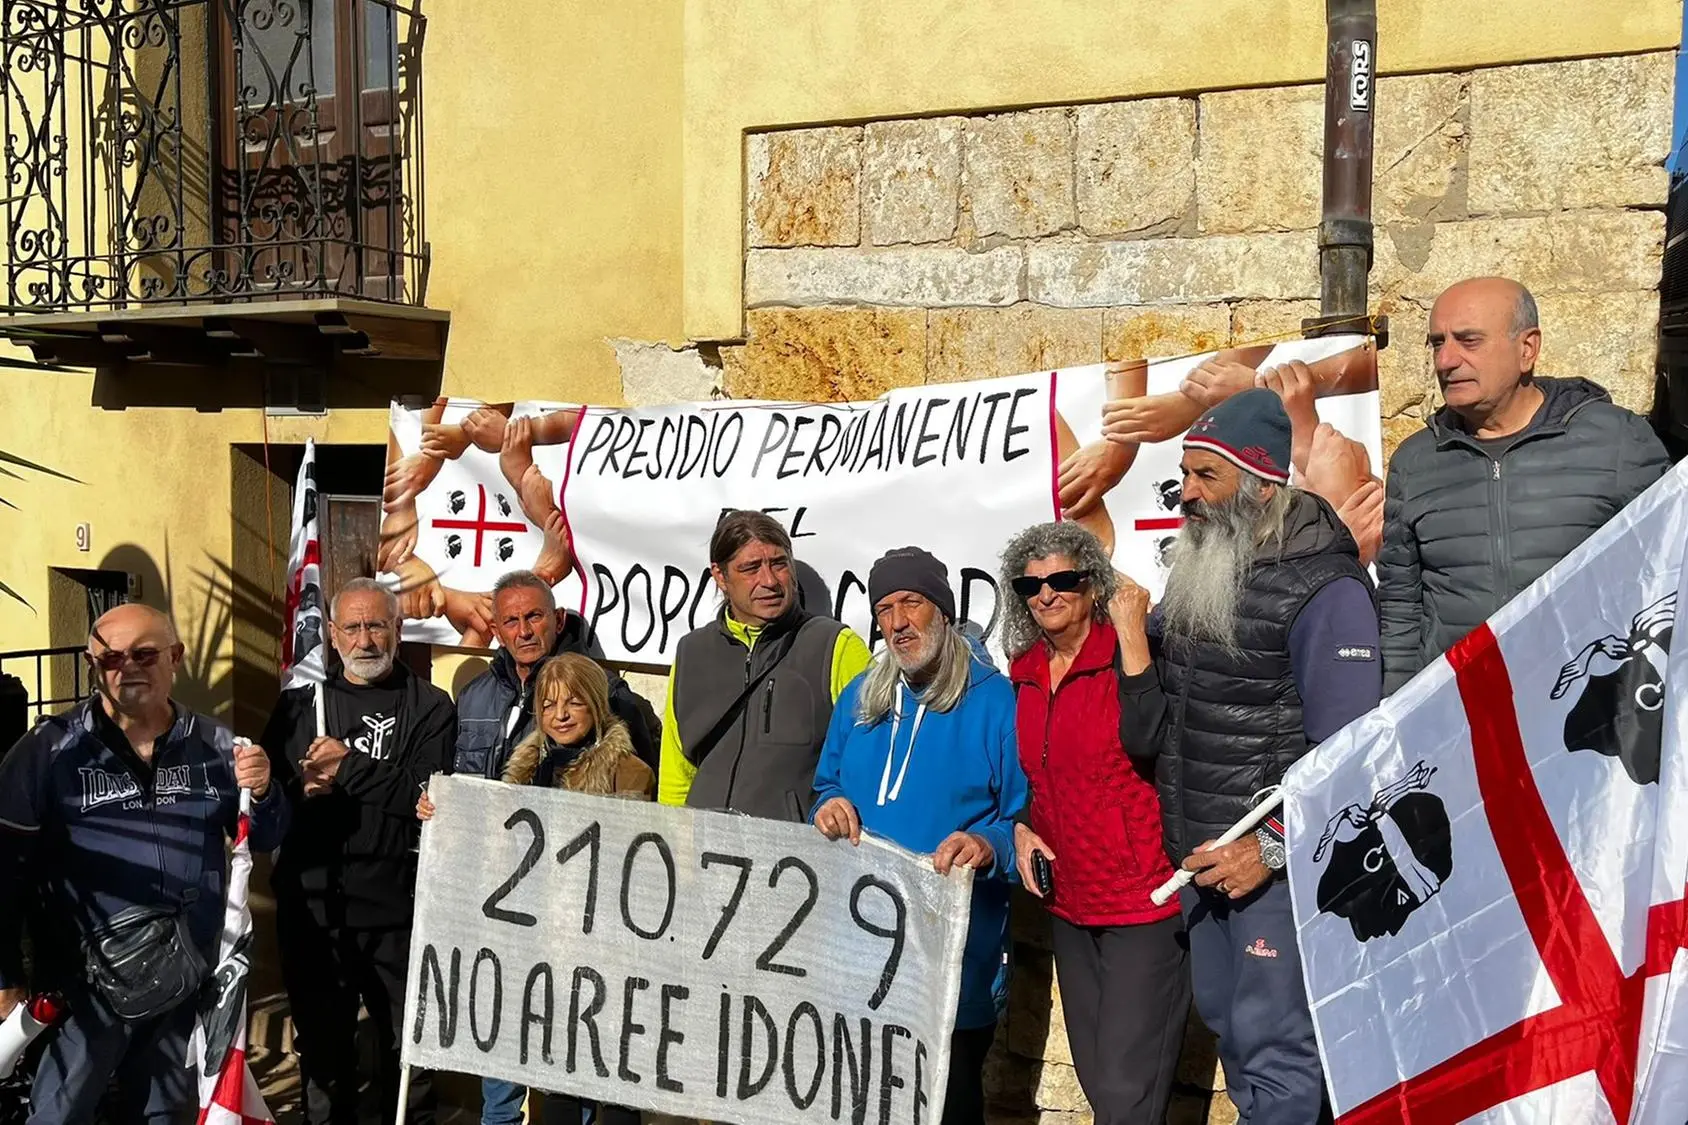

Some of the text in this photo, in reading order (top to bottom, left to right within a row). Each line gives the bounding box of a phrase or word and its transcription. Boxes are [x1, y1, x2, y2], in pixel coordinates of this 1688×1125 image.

[1352, 41, 1370, 109] KORS
[577, 388, 1038, 481] PRESIDIO PERMANENTE
[76, 526, 85, 548] 9
[482, 808, 907, 1011] 210.729
[413, 943, 503, 1053] NO
[519, 961, 690, 1094] AREE
